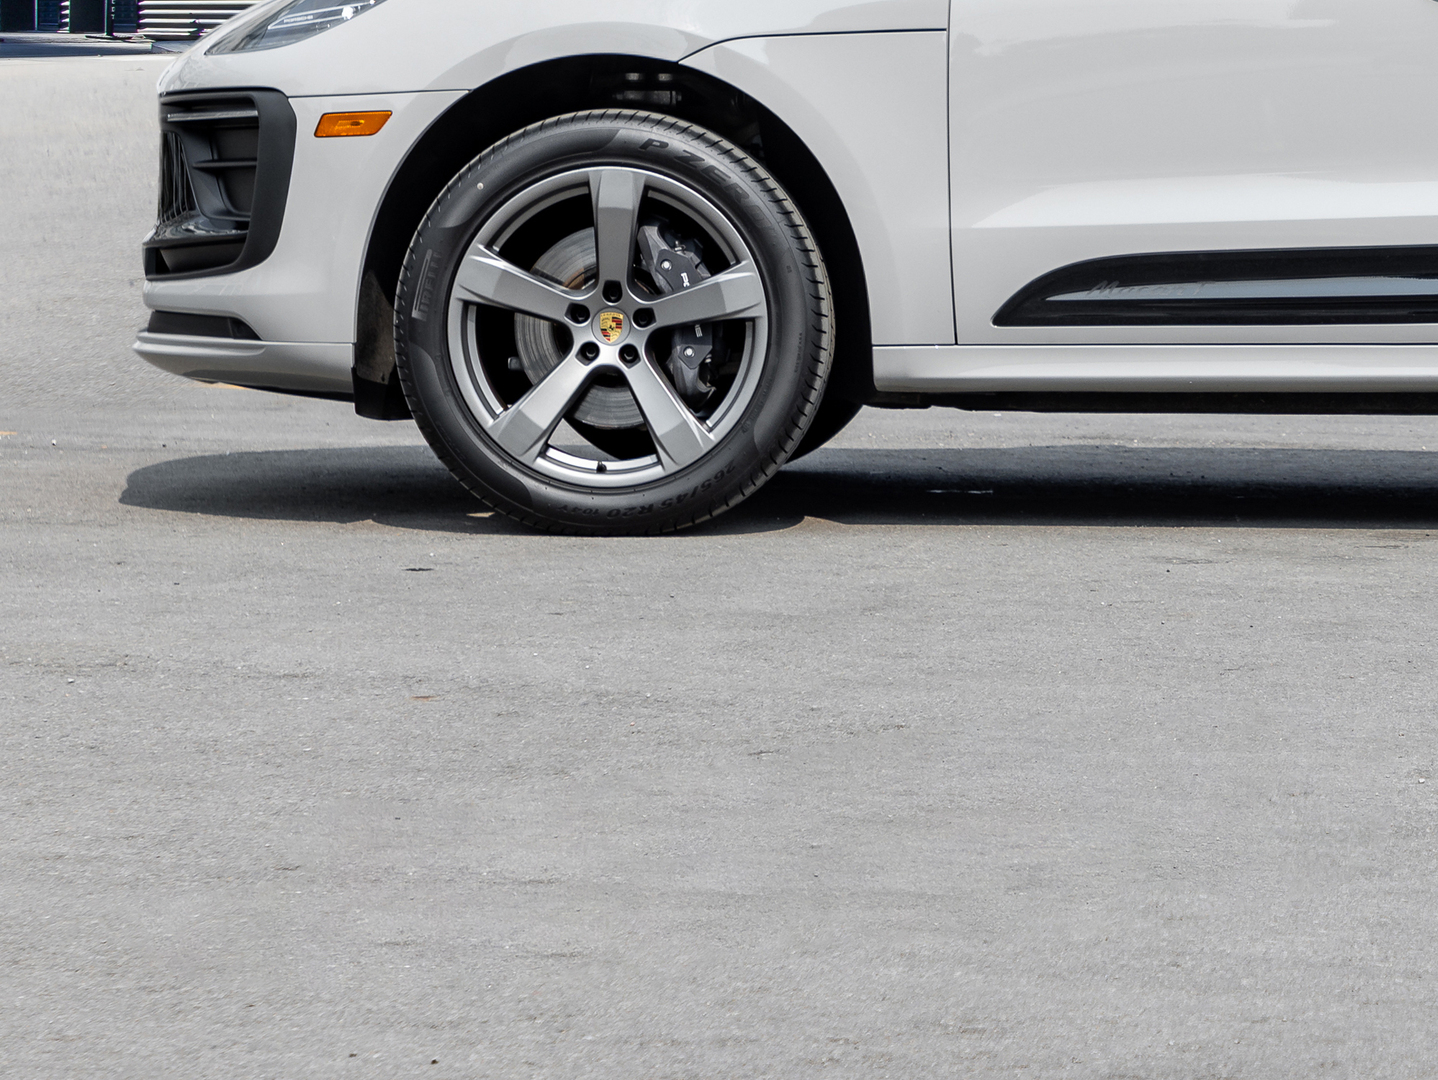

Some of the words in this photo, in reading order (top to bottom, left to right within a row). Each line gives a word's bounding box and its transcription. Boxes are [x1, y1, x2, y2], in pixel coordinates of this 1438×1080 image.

[638, 138, 669, 152] P
[659, 459, 735, 511] 265/45
[606, 503, 655, 519] R20
